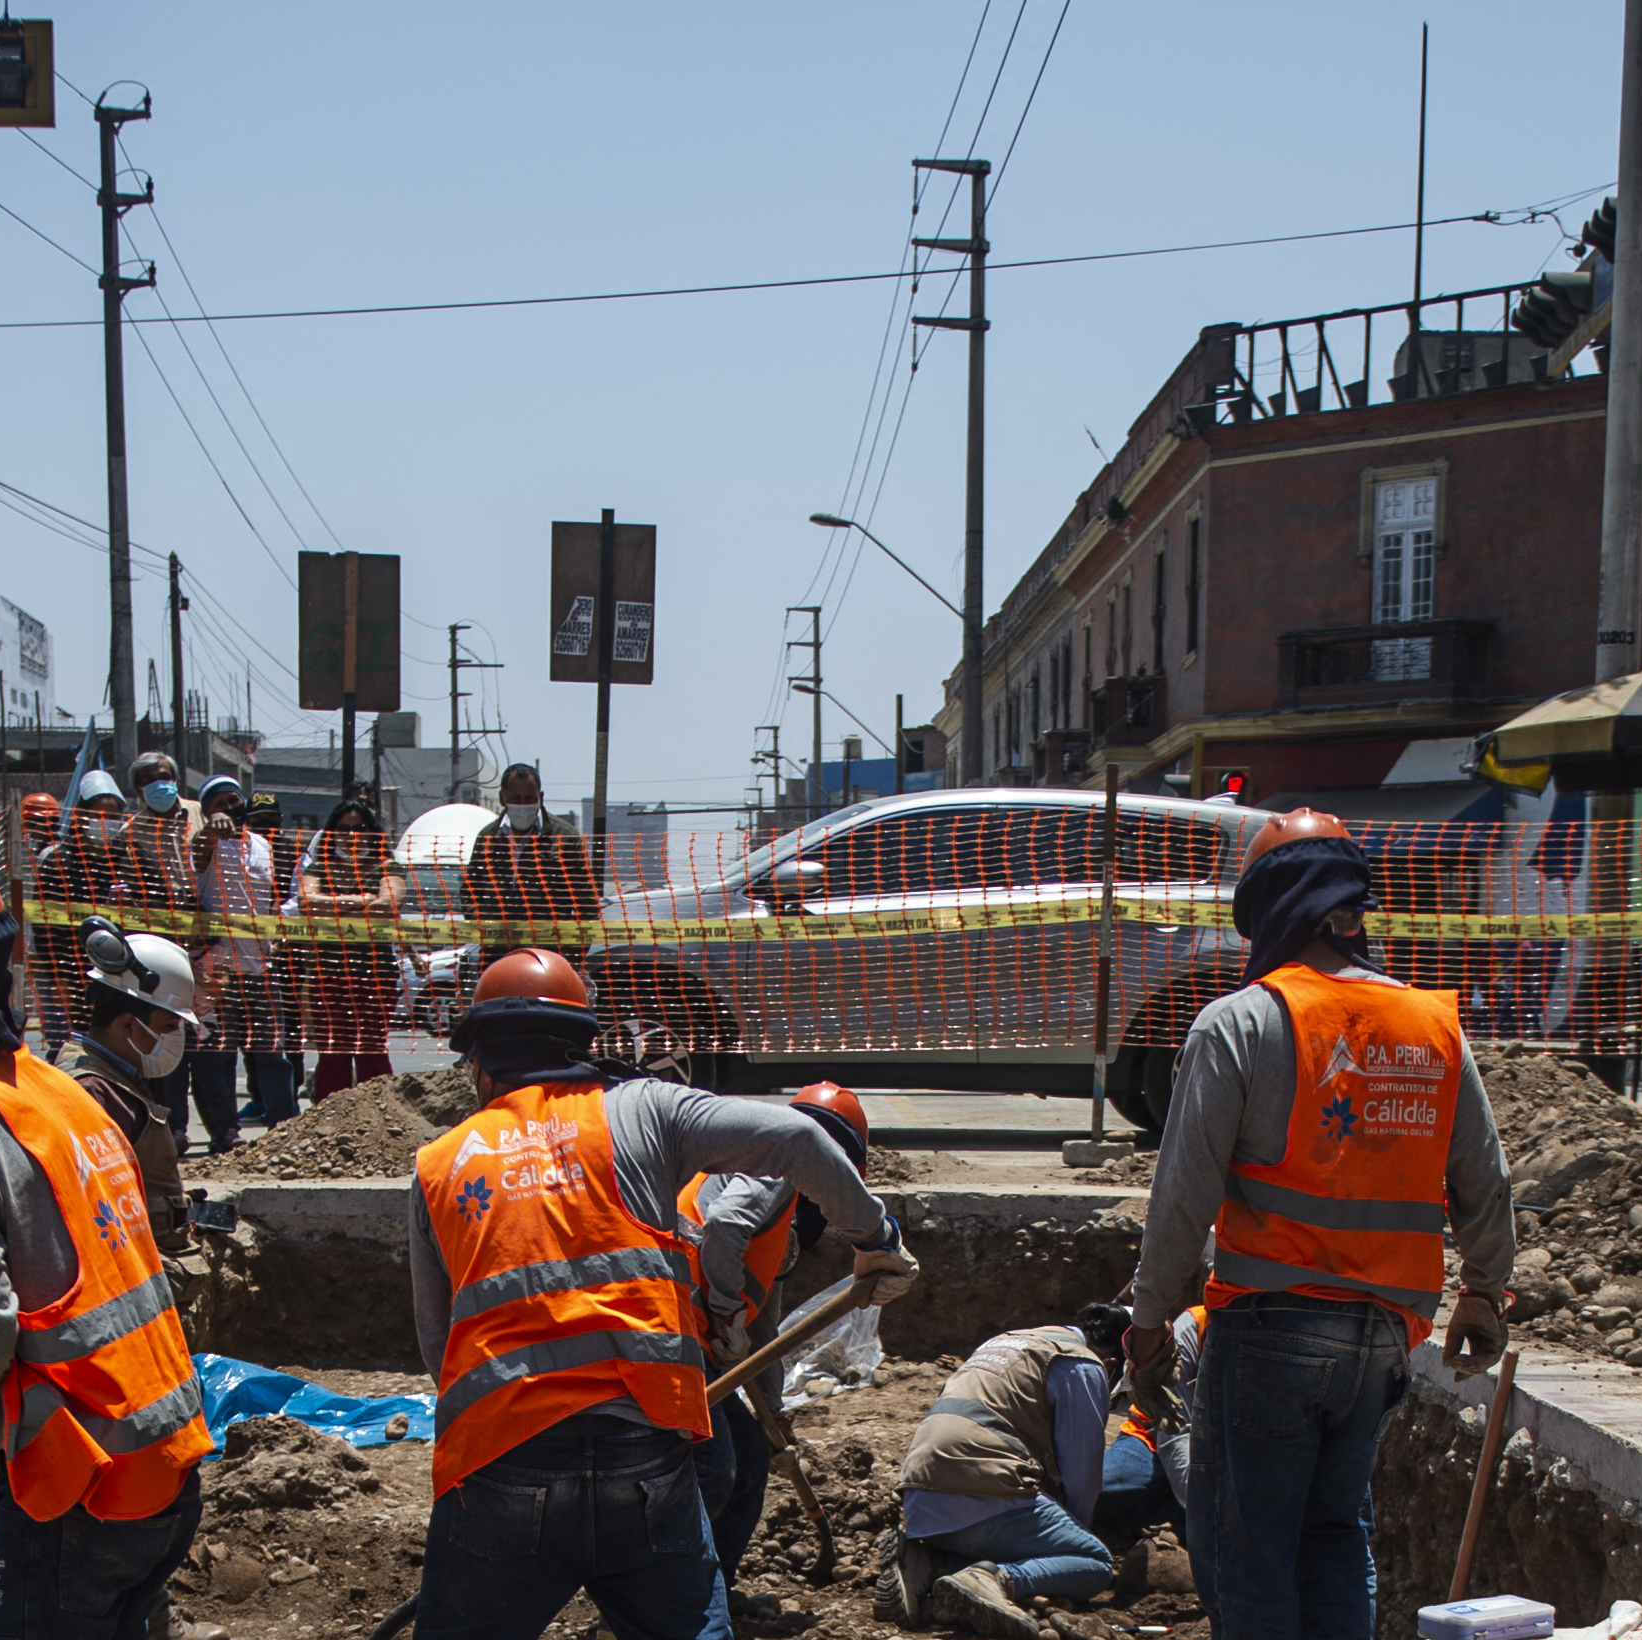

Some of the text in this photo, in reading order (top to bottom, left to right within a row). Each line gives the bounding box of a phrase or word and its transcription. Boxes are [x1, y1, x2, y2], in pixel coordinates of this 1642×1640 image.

[1395, 1042, 1431, 1066] PERÚ
[1368, 1082, 1438, 1095] CONTRATISTA DE
[1363, 1099, 1437, 1125] Cálidda
[501, 1160, 584, 1191] Cálidda
